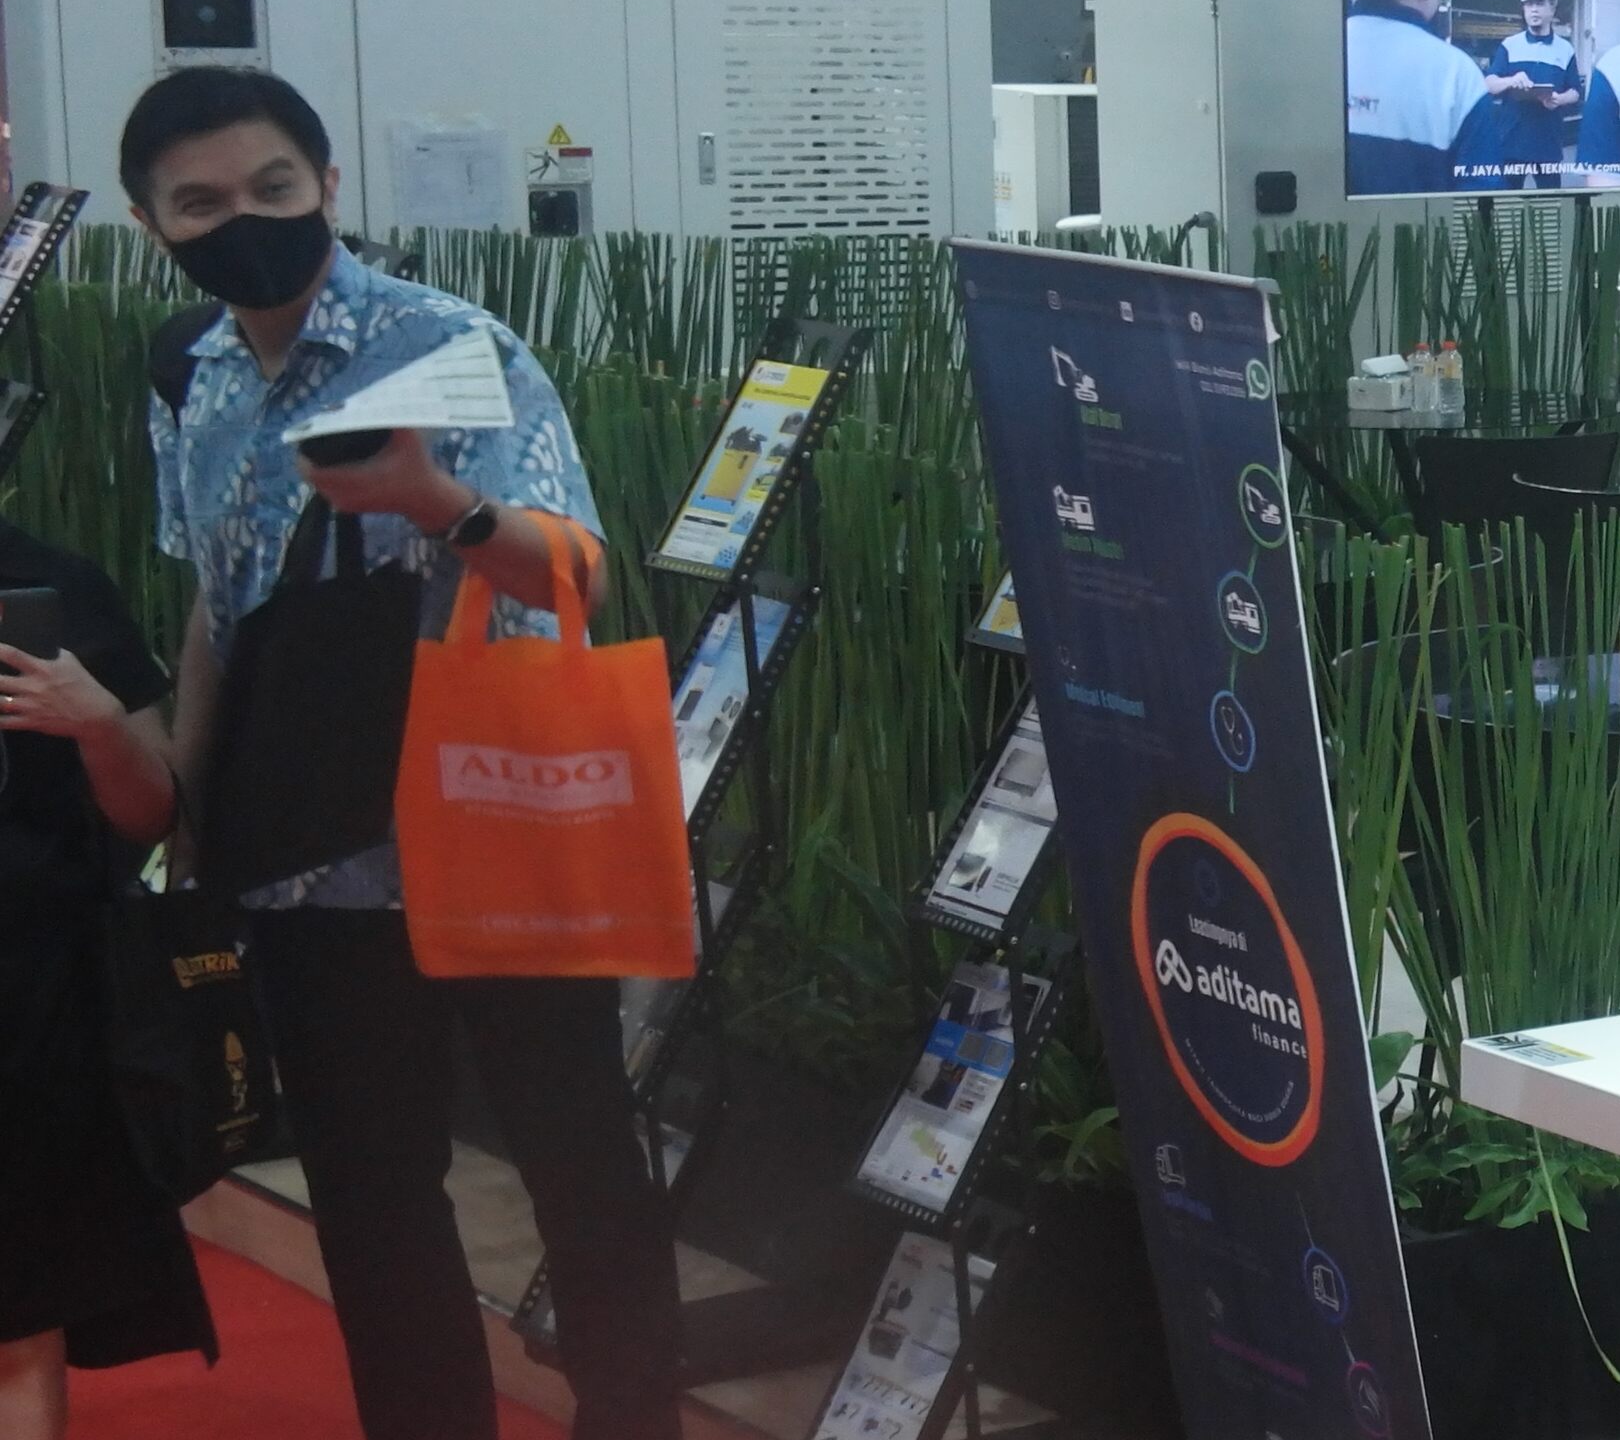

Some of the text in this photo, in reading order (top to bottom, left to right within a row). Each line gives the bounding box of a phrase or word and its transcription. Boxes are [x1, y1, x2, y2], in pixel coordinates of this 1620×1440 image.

[1454, 165, 1469, 177] PT.
[1471, 164, 1502, 177] JAYA
[1503, 163, 1540, 176] METAL
[460, 753, 616, 790] ALDO
[1197, 961, 1303, 1031] aditama
[1251, 1022, 1308, 1060] finance
